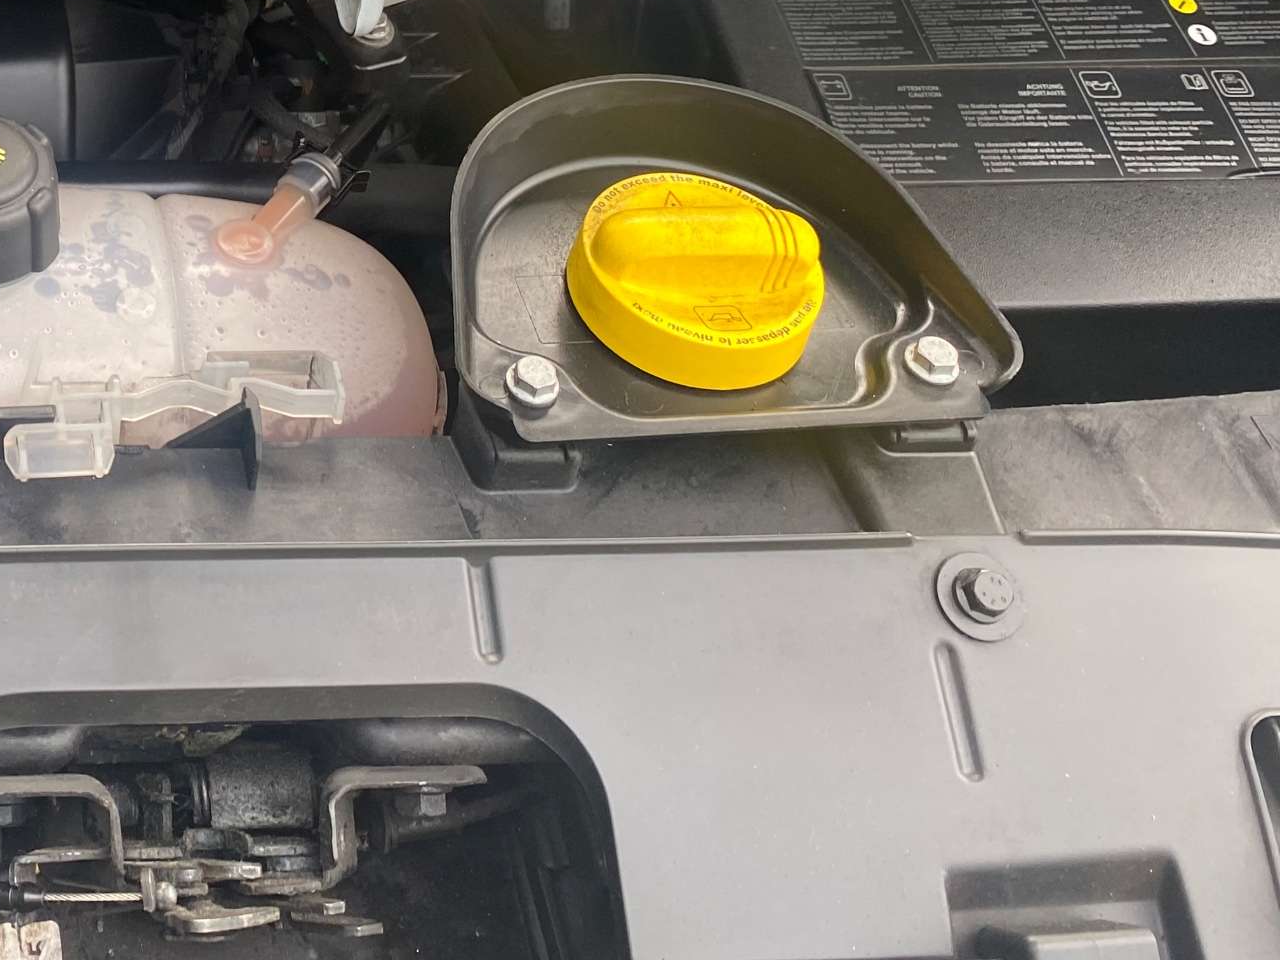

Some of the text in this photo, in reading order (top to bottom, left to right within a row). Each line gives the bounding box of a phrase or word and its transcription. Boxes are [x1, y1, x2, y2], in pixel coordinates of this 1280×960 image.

[592, 201, 606, 214] Do
[604, 190, 620, 207] not
[622, 175, 667, 192] exceed
[670, 175, 694, 184] the
[698, 179, 735, 193] maxi
[718, 336, 732, 346] le
